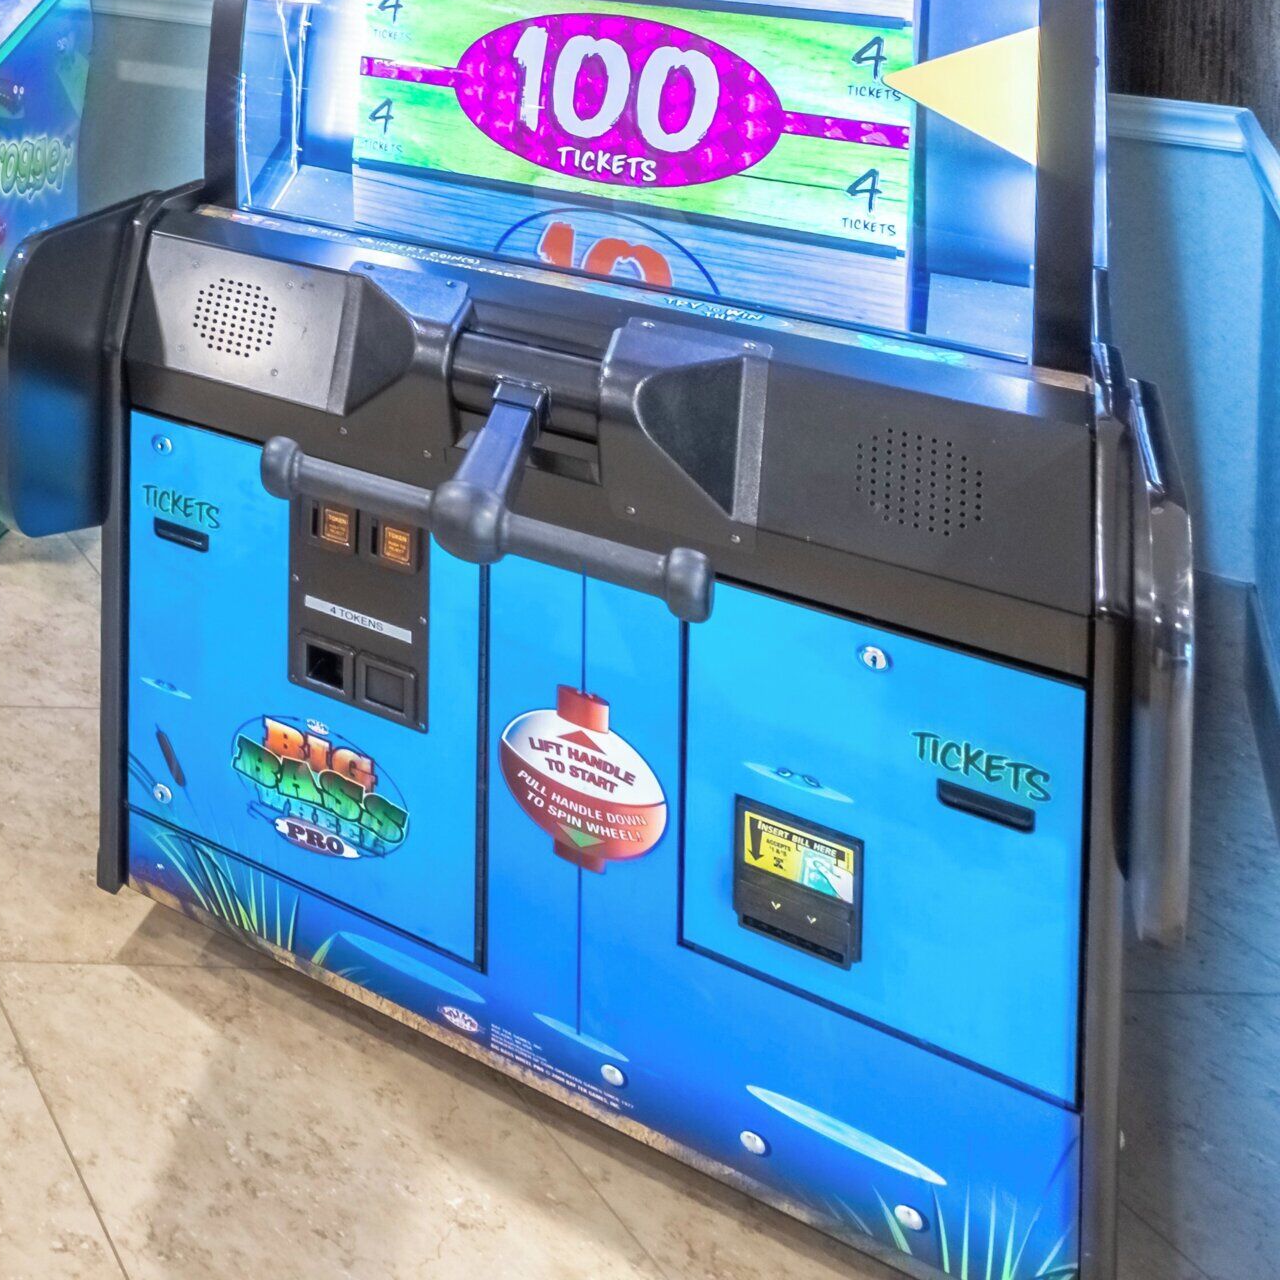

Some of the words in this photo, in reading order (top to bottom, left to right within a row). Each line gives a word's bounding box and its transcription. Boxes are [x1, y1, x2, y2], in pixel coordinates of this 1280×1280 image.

[373, 27, 413, 41] TICKETS
[851, 36, 887, 80] 4
[512, 24, 719, 155] 100
[847, 84, 902, 102] TICKETS
[368, 98, 394, 135] 4
[557, 145, 656, 183] TICKETS
[846, 168, 882, 213] 4
[841, 216, 897, 236] TICKETS
[536, 219, 672, 290] 10
[664, 296, 702, 311] TRY
[726, 308, 764, 321] WIN
[142, 484, 220, 529] TICKETS
[330, 606, 336, 615] 4
[339, 608, 384, 632] TOKENS
[263, 715, 378, 794] BIG
[529, 737, 563, 756] LIFT
[567, 746, 636, 787] HANDLE
[912, 730, 1052, 803] TICKETS
[231, 732, 410, 843] BASS
[545, 757, 565, 774] TO
[569, 765, 618, 794] START
[517, 770, 547, 797] PULL
[551, 792, 603, 821] HANDLE
[606, 812, 648, 826] DOWN
[527, 790, 544, 808] TO
[547, 804, 582, 829] SPIN
[586, 821, 643, 843] WHEEL!
[286, 822, 345, 856] PRO
[757, 820, 789, 838] INSERT
[791, 832, 810, 848] BILL
[813, 842, 837, 858] HERE
[766, 838, 791, 852] ACCEPTS
